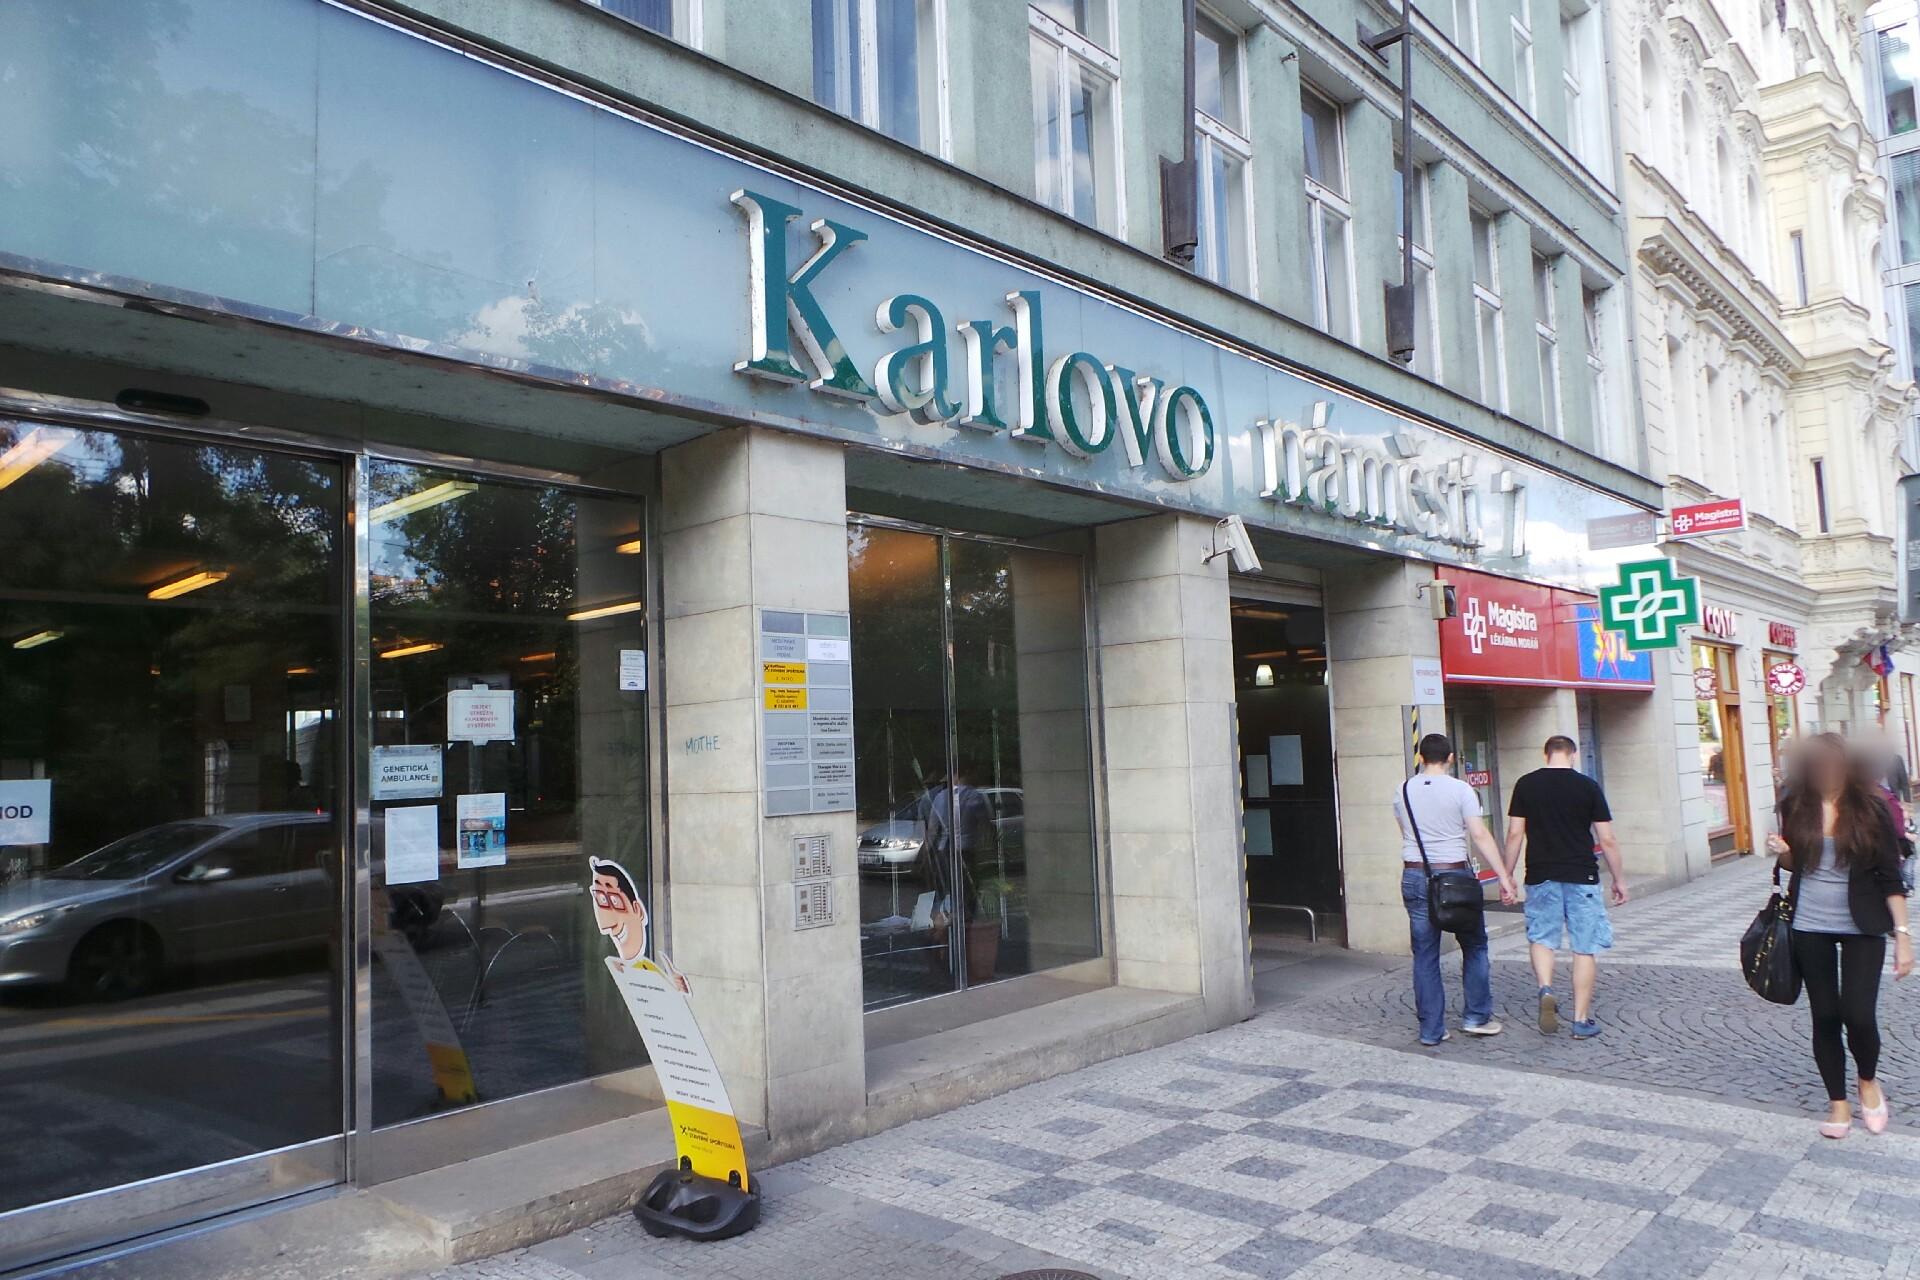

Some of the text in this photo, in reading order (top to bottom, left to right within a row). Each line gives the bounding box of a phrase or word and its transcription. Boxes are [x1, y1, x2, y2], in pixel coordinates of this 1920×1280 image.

[730, 189, 1214, 481] Karlovo
[1254, 401, 1484, 548] náměstí
[1695, 508, 1740, 521] Magistra
[1488, 601, 1537, 633] Magistra
[1703, 605, 1737, 639] COSTA
[381, 773, 431, 783] AMBULANCE
[383, 763, 429, 774] GENETICKÁ
